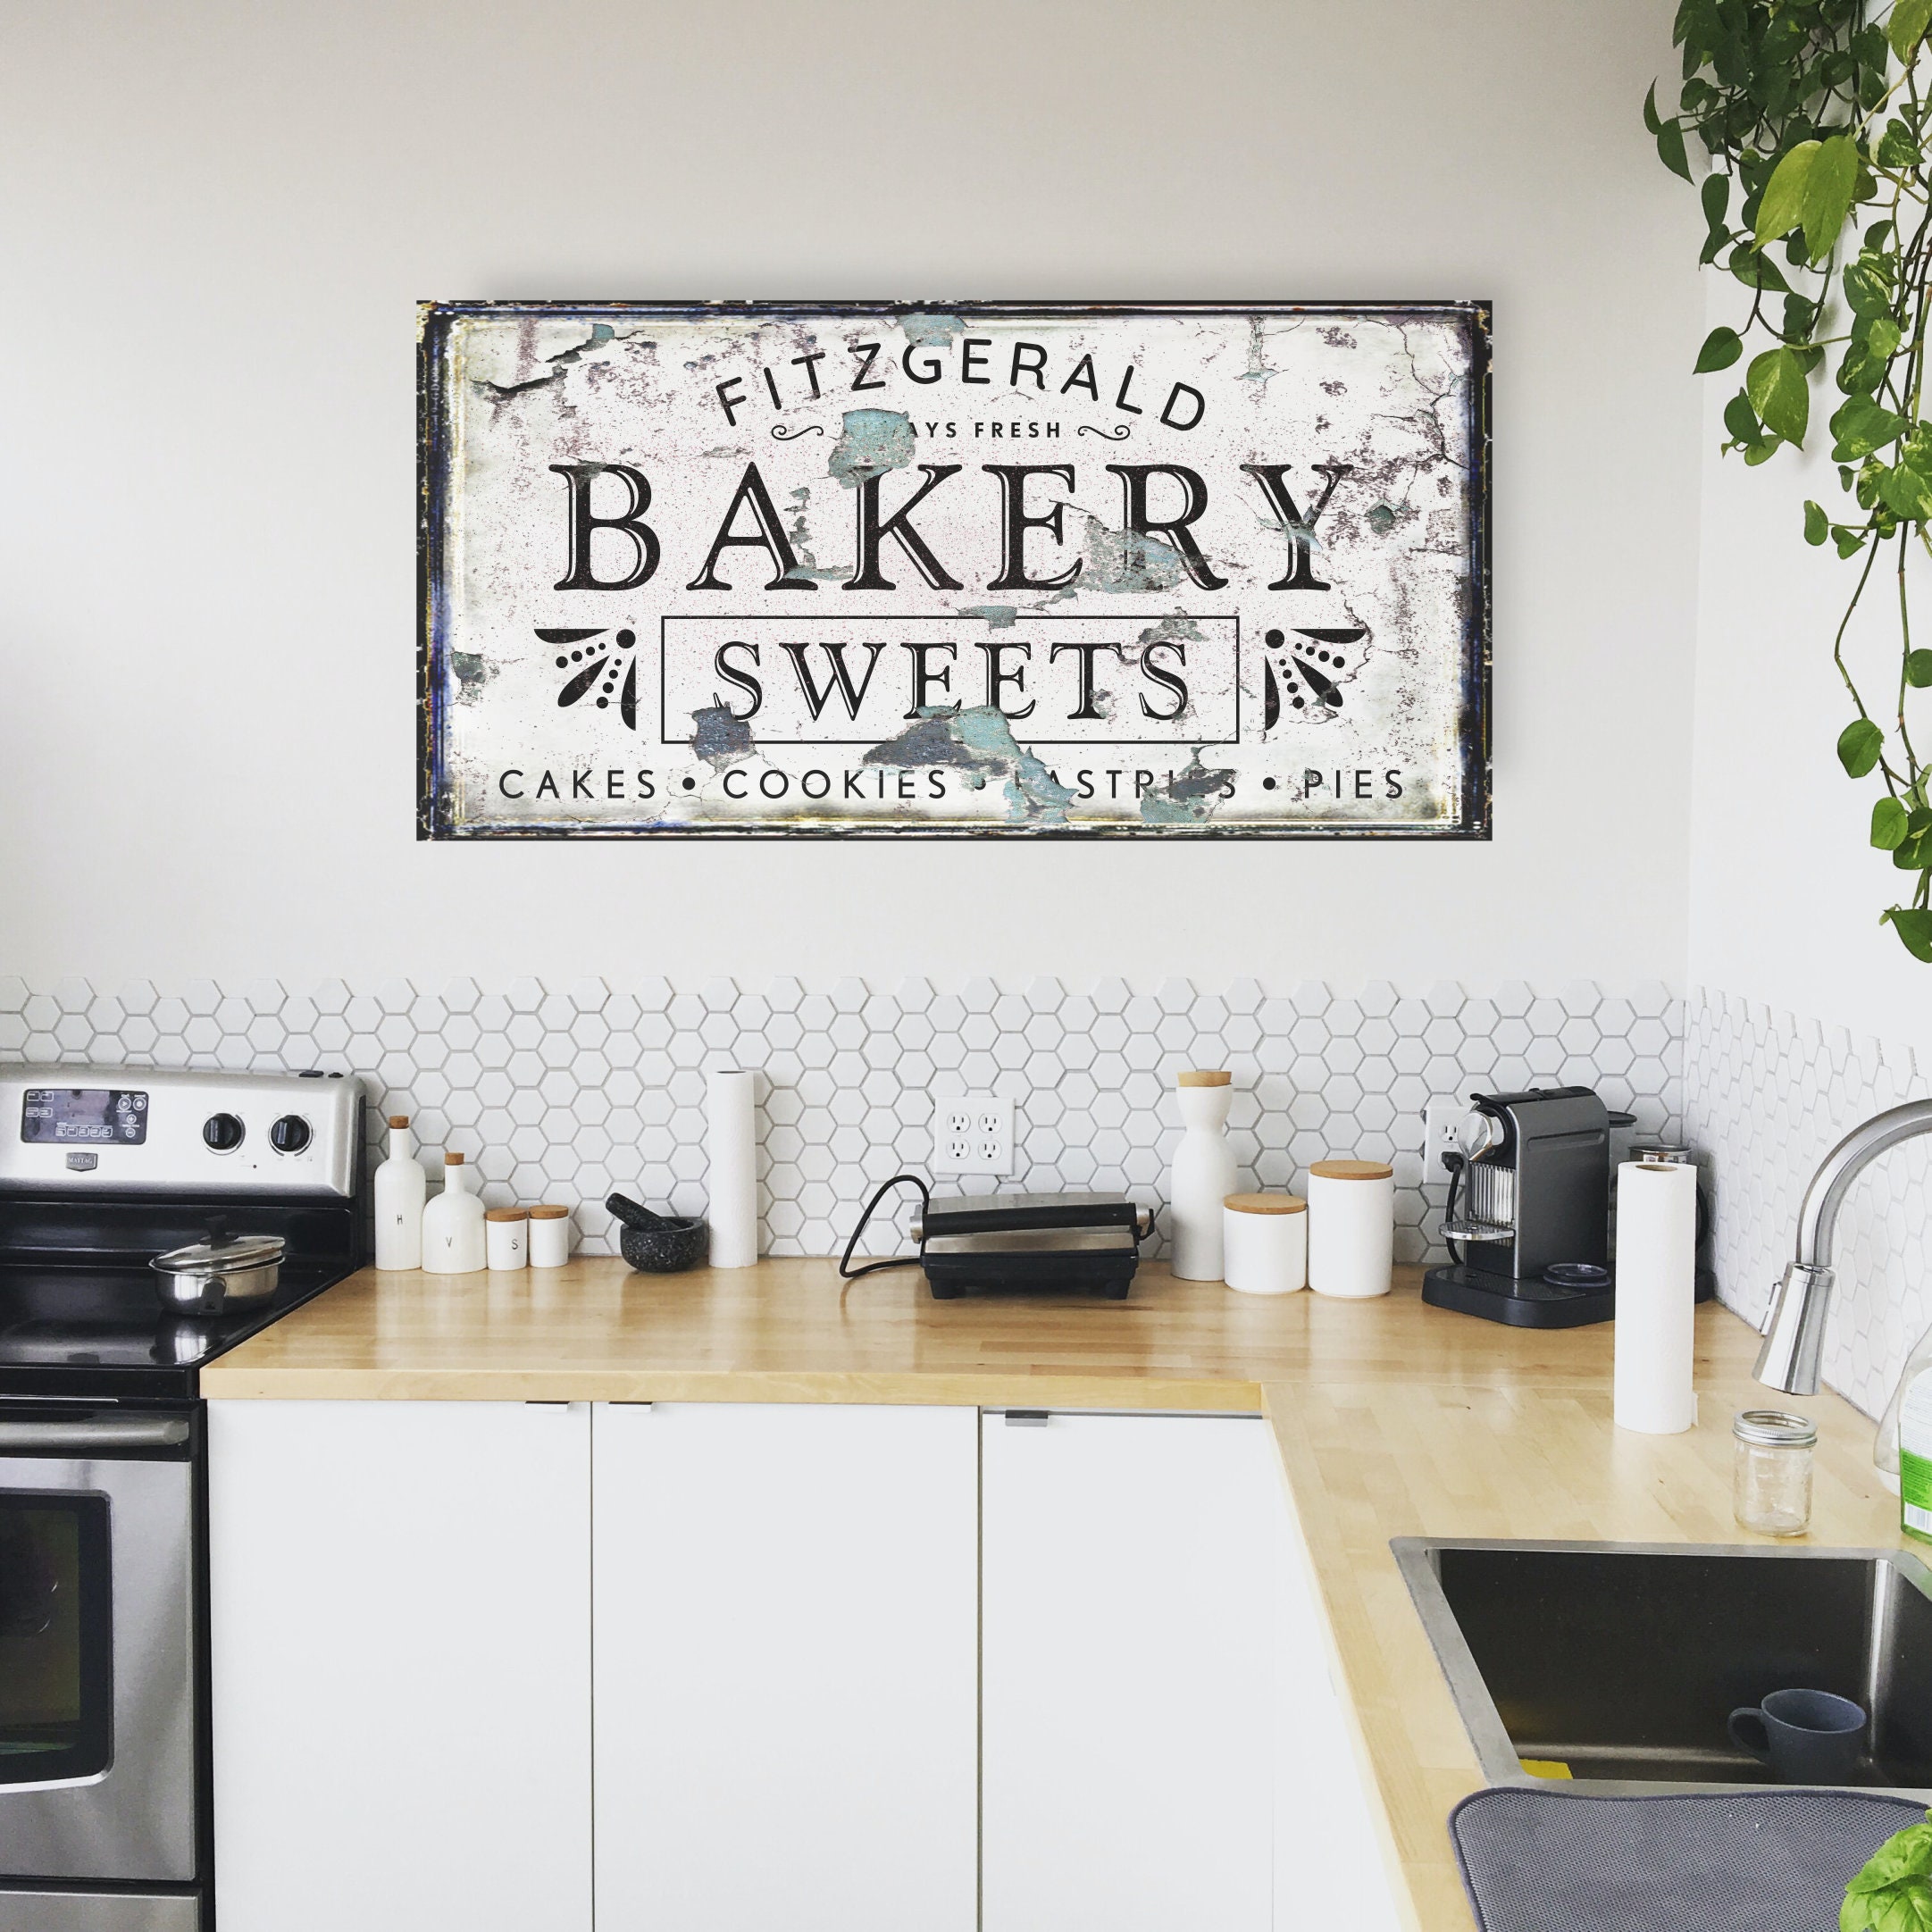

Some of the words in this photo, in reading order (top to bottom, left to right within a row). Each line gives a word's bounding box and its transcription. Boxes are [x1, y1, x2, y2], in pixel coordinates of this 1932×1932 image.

[716, 339, 1205, 431] FITZGERALD
[974, 422, 1060, 438] FRESH
[548, 461, 1354, 591] BAKERY
[713, 640, 1189, 722] SWEETS
[500, 769, 655, 799] CAKES
[723, 769, 946, 799] COOKIES
[1016, 769, 1235, 799] STRIS
[1304, 769, 1403, 799] PIES
[397, 1214, 403, 1225] H
[446, 1236, 453, 1248] V
[511, 1239, 519, 1250] S
